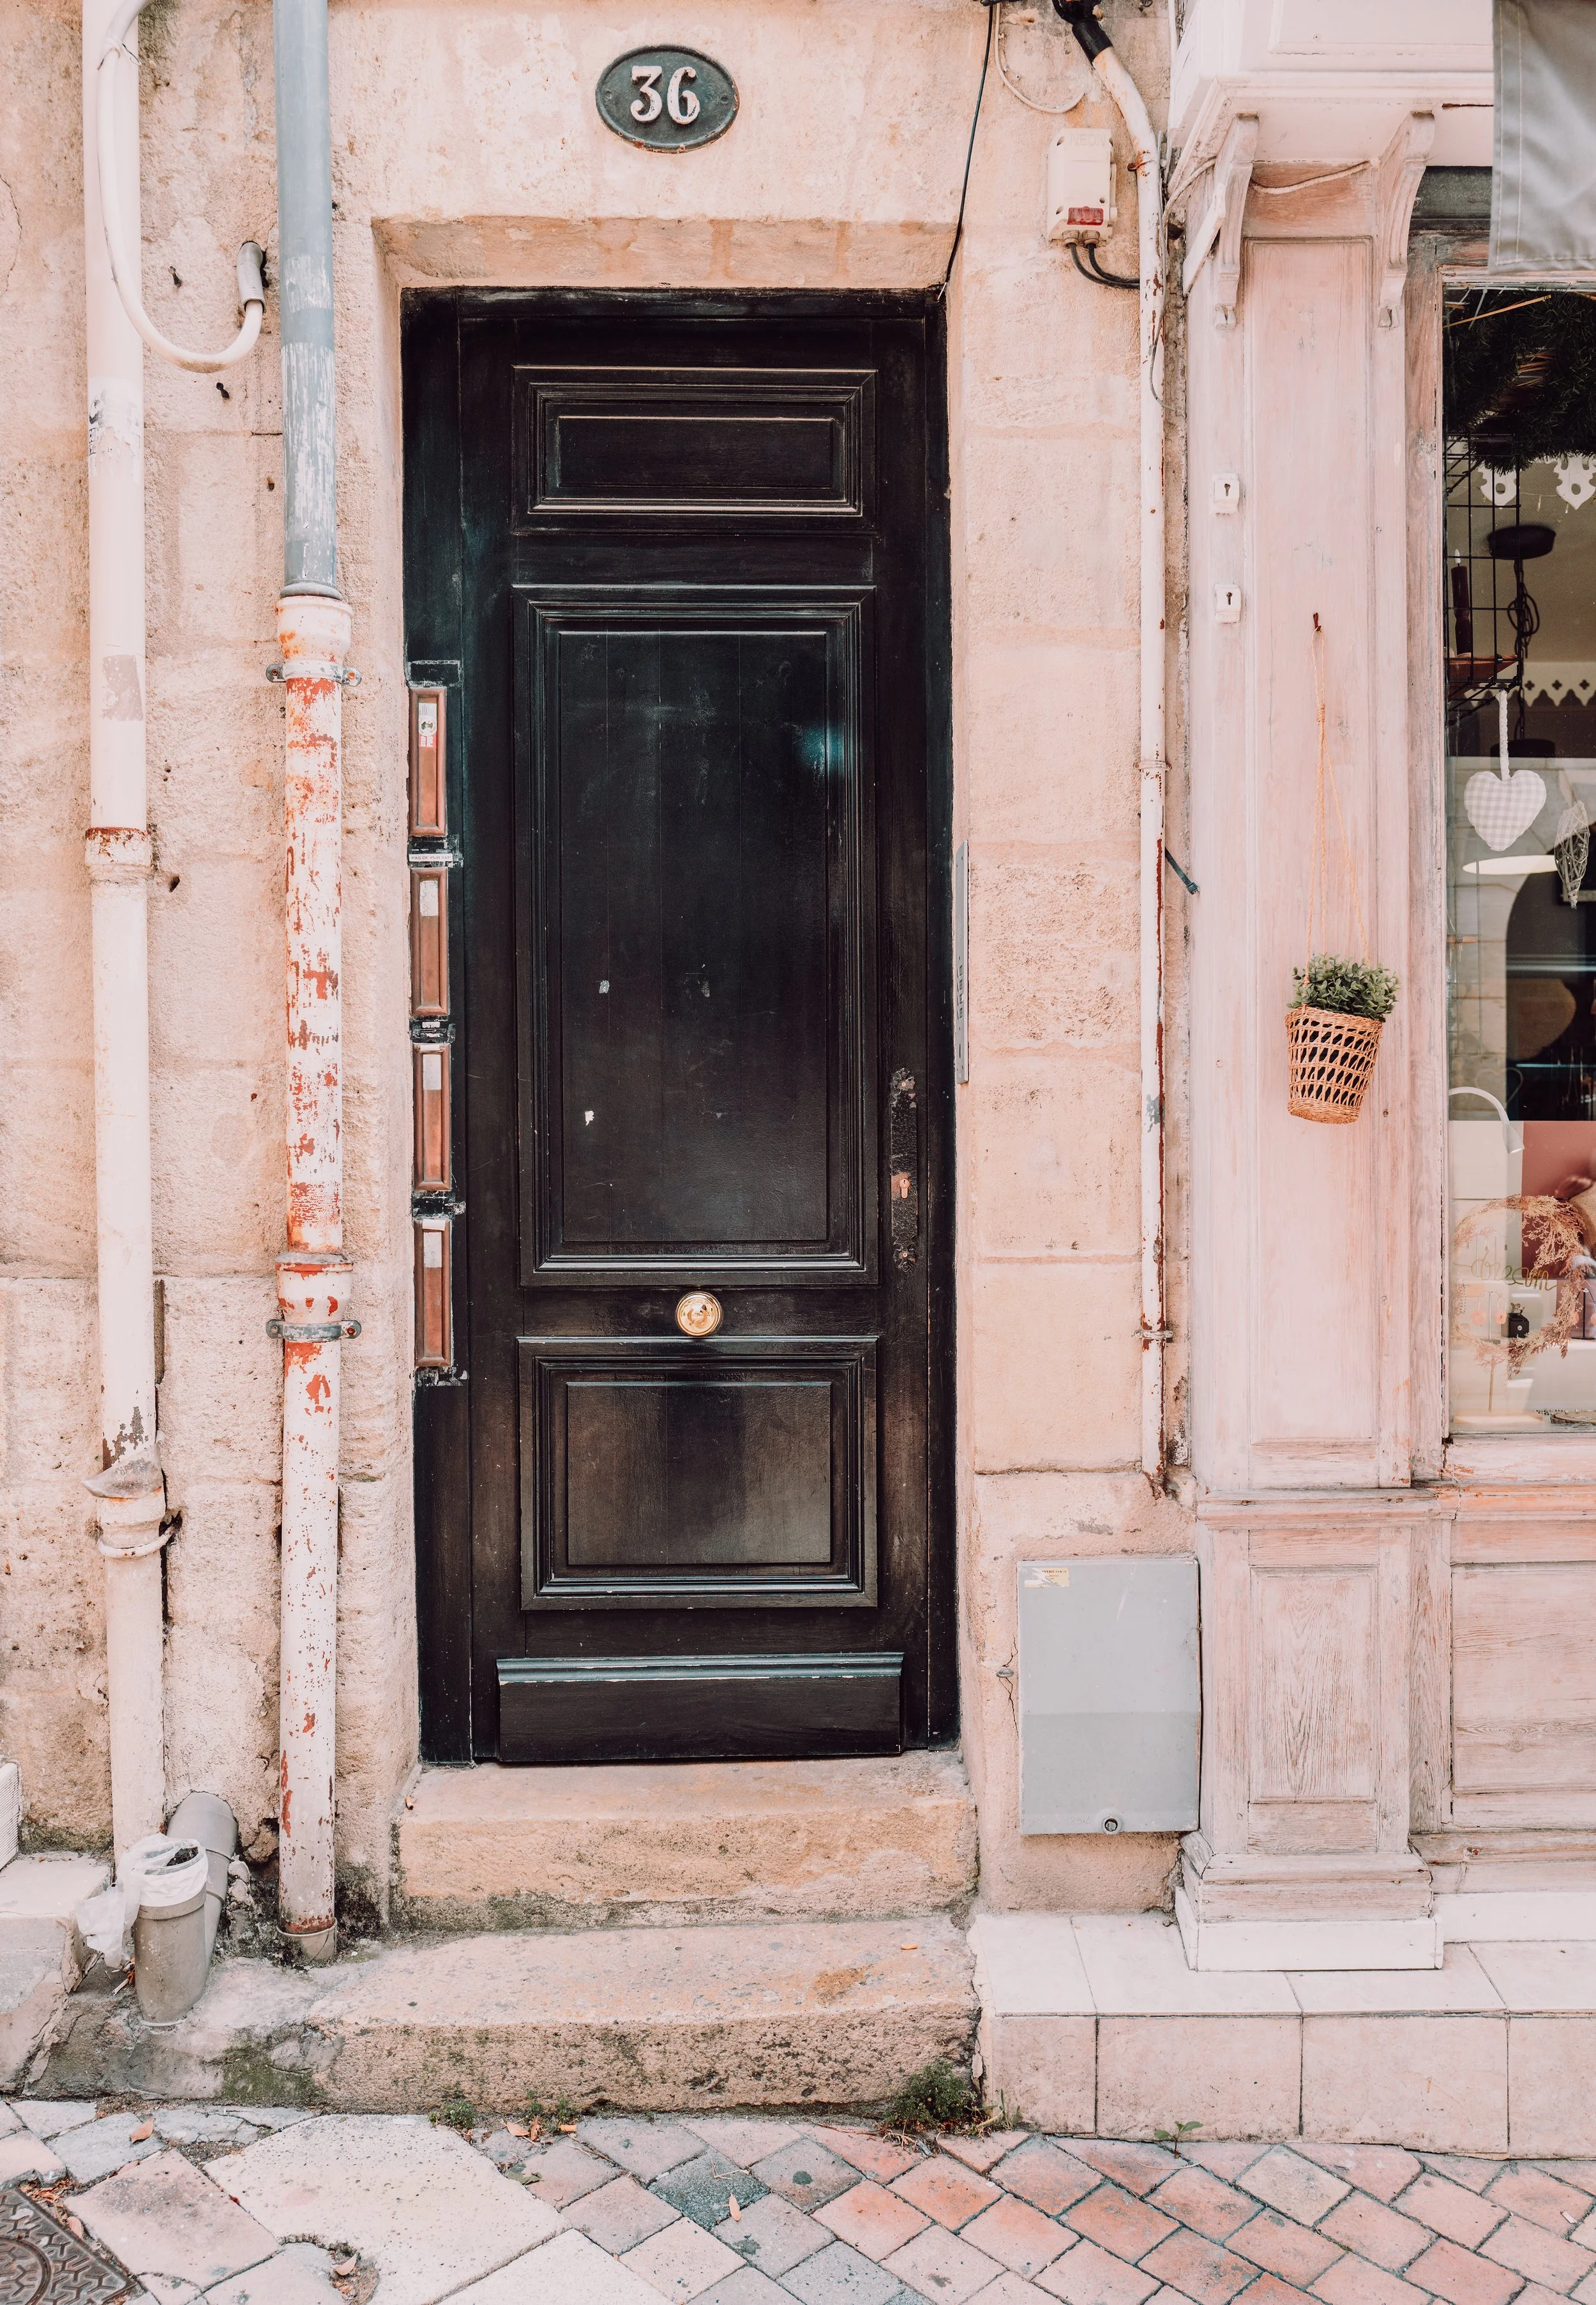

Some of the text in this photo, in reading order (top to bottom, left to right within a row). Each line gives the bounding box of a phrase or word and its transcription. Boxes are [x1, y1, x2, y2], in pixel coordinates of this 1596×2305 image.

[630, 66, 700, 124] 36
[1070, 133, 1106, 146] NEON
[1471, 1249, 1555, 1291] dream
